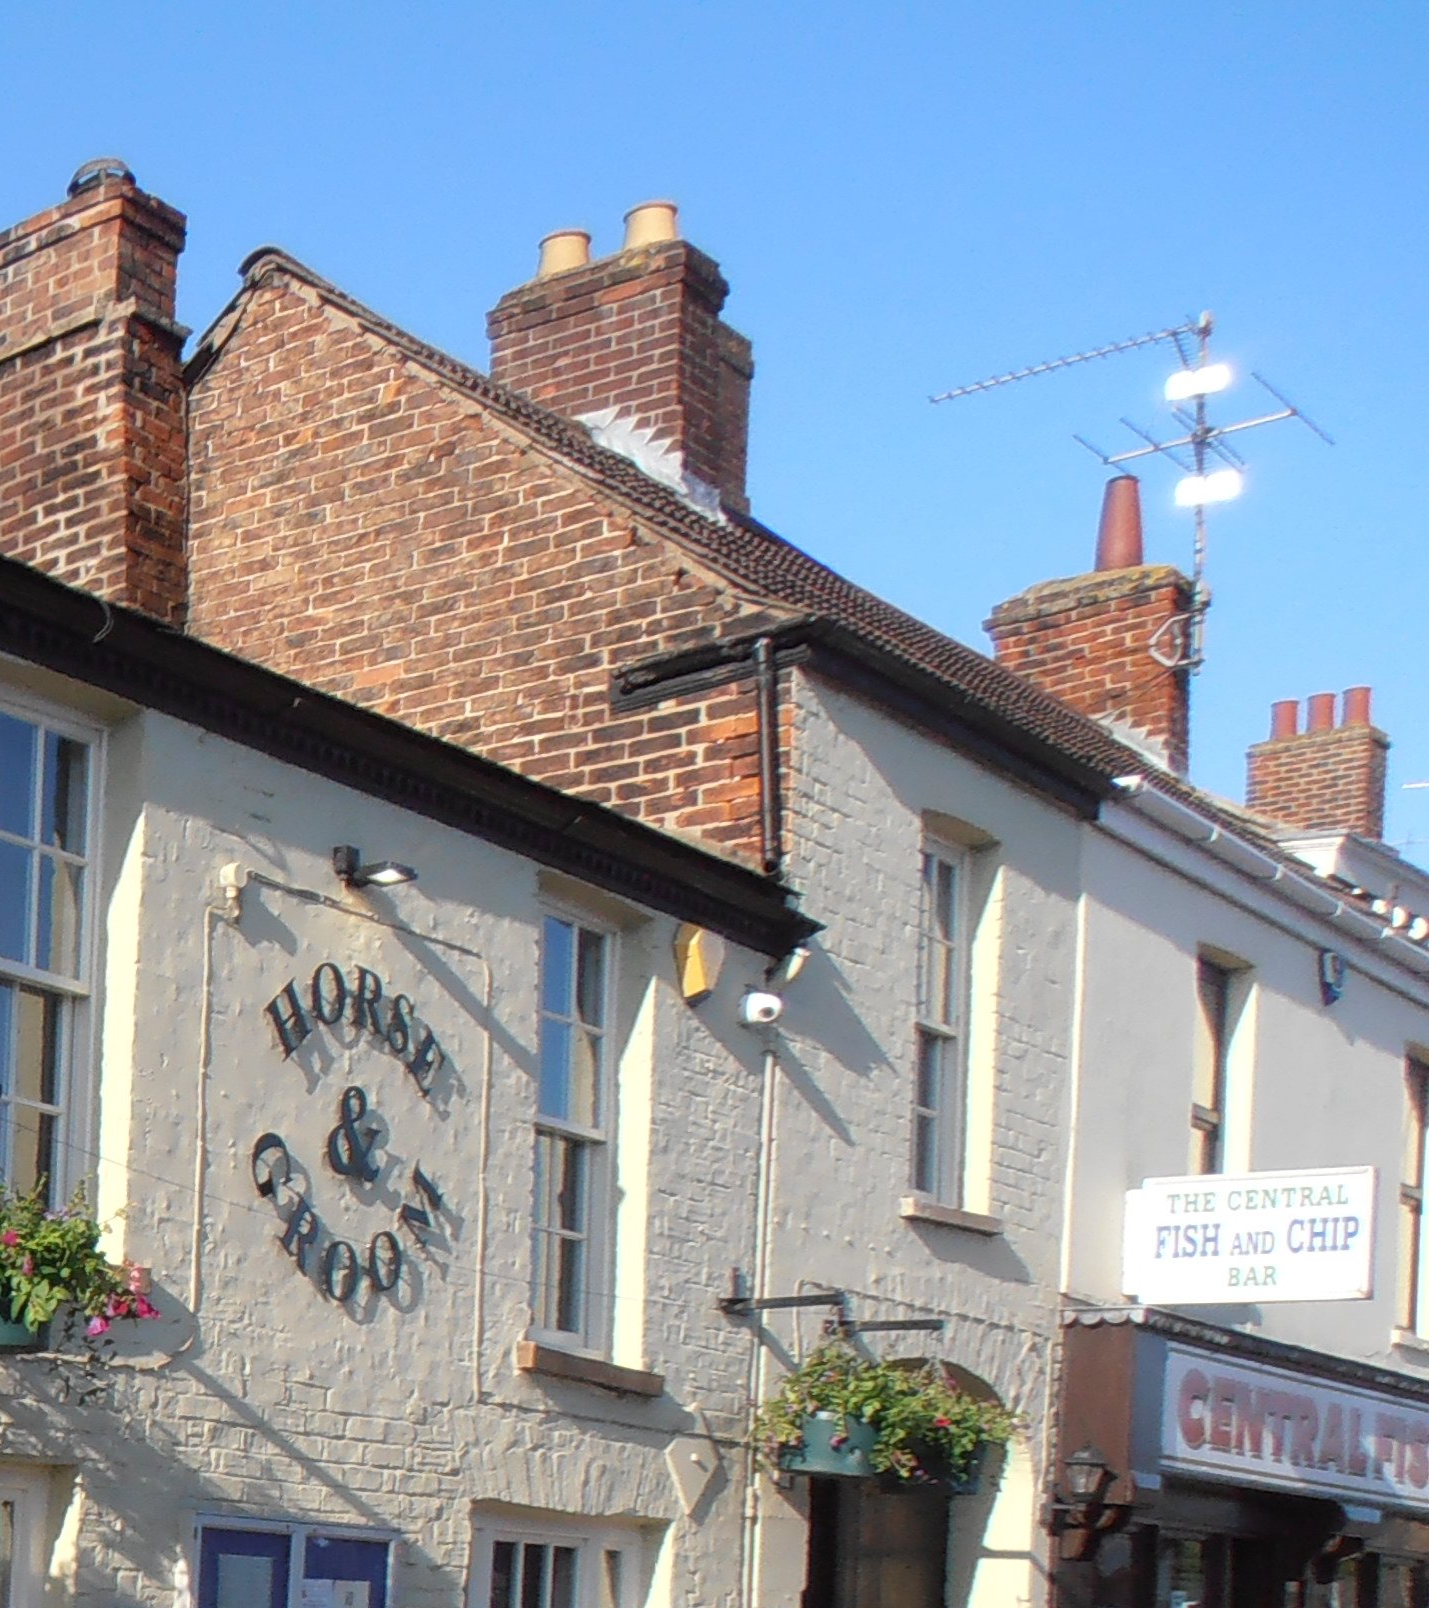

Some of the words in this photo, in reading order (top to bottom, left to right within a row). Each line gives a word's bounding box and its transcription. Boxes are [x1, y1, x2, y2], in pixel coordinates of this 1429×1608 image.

[264, 962, 445, 1098] HORSE
[328, 1085, 380, 1181] &
[252, 1132, 445, 1301] GROOM
[1154, 1223, 1221, 1259] FISH
[1229, 1231, 1275, 1256] AND
[1287, 1216, 1359, 1253] CHIP
[1167, 1191, 1216, 1214] THE
[1227, 1184, 1349, 1211] CENTRAL
[1227, 1265, 1277, 1287] BAR
[1178, 1368, 1368, 1477] CENTRAL
